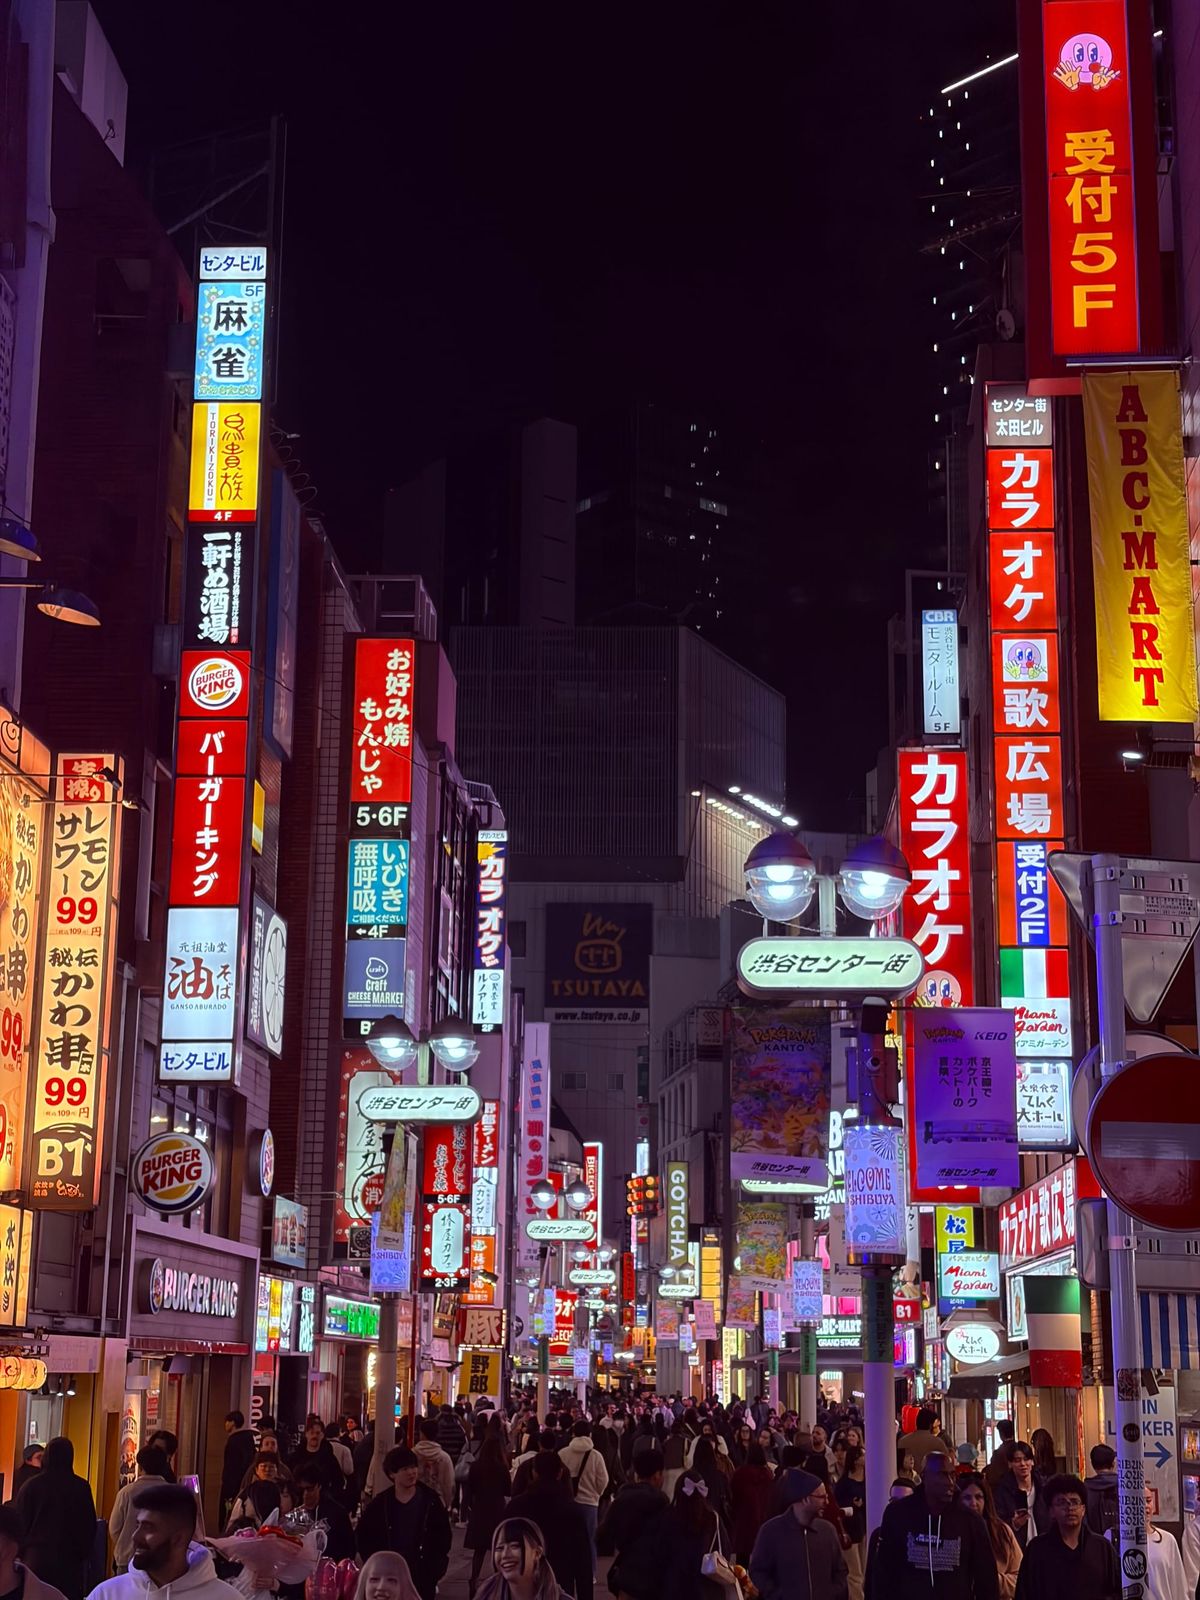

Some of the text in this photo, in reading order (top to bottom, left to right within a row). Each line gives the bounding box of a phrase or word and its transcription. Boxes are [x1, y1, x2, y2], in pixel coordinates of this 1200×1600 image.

[1065, 129, 1118, 328] 受付5F
[202, 254, 264, 273] センタービル
[244, 285, 264, 297] 5F
[212, 300, 248, 379] 麻雀
[992, 399, 1046, 412] センター街
[996, 420, 1043, 436] 太田ビル
[206, 412, 216, 496] TORIKIZOKU
[214, 511, 232, 521] 4F
[199, 531, 233, 644] 一軒め酒場
[925, 612, 953, 622] CBR
[196, 668, 234, 687] BURGER
[928, 627, 942, 717] モニタールーム
[197, 677, 236, 698] KING
[384, 648, 411, 748] お好み焼
[934, 723, 950, 731] 5F
[357, 697, 383, 794] もんじゃ
[1003, 688, 1051, 834] 歌広場
[193, 731, 225, 897] バーガーキング
[54, 813, 82, 895] サワー
[81, 807, 107, 892] レモン
[910, 754, 963, 964] カラオケ
[352, 842, 378, 913] 無呼吸
[381, 842, 407, 912] いびき
[1017, 844, 1046, 943] 受付2F
[57, 897, 97, 924] 99
[478, 857, 504, 955] カラオケ
[352, 914, 403, 923] ご相談ください
[367, 925, 389, 938] 4F
[49, 948, 98, 967] 秘伝
[179, 942, 228, 953] 元祖油堂
[748, 954, 912, 973] 渋谷センター街
[168, 957, 214, 1000] 油
[216, 964, 234, 1000] そば
[365, 979, 387, 991] Craft
[551, 979, 646, 996] TSUTAYA
[348, 991, 404, 1004] CHEESE MARKET
[46, 971, 94, 1070] かわ串
[554, 1011, 641, 1022] www.tsutaya.co.jp
[1014, 1007, 1057, 1019] Miami
[360, 1021, 375, 1035] B
[481, 1024, 493, 1032] 2F
[975, 1032, 1008, 1041] KEIO
[163, 1052, 230, 1071] センタービル
[45, 1077, 87, 1106] 99
[953, 1057, 963, 1107] カントーの
[1019, 1084, 1059, 1093] 大衆食堂
[366, 1097, 474, 1109] 渋谷センター街
[1023, 1095, 1055, 1108] てんぐ
[1017, 1109, 1063, 1122] 大ホール
[480, 1103, 496, 1165] 野郎ラーメン
[37, 1138, 85, 1177] B1
[142, 1148, 200, 1176] BURGER
[752, 1162, 810, 1174] 渋谷センター街
[143, 1162, 202, 1195] KING
[850, 1194, 896, 1205] SHIBUYA
[671, 1169, 685, 1260] GOTCHA
[1001, 1167, 1074, 1262] カラオケ歌広場
[944, 1266, 987, 1277] Miami
[163, 1268, 211, 1315] BURGER
[211, 1278, 238, 1319] KING
[896, 1305, 911, 1318] B1
[464, 1310, 500, 1344] 豚
[469, 1355, 489, 1392] 野郎
